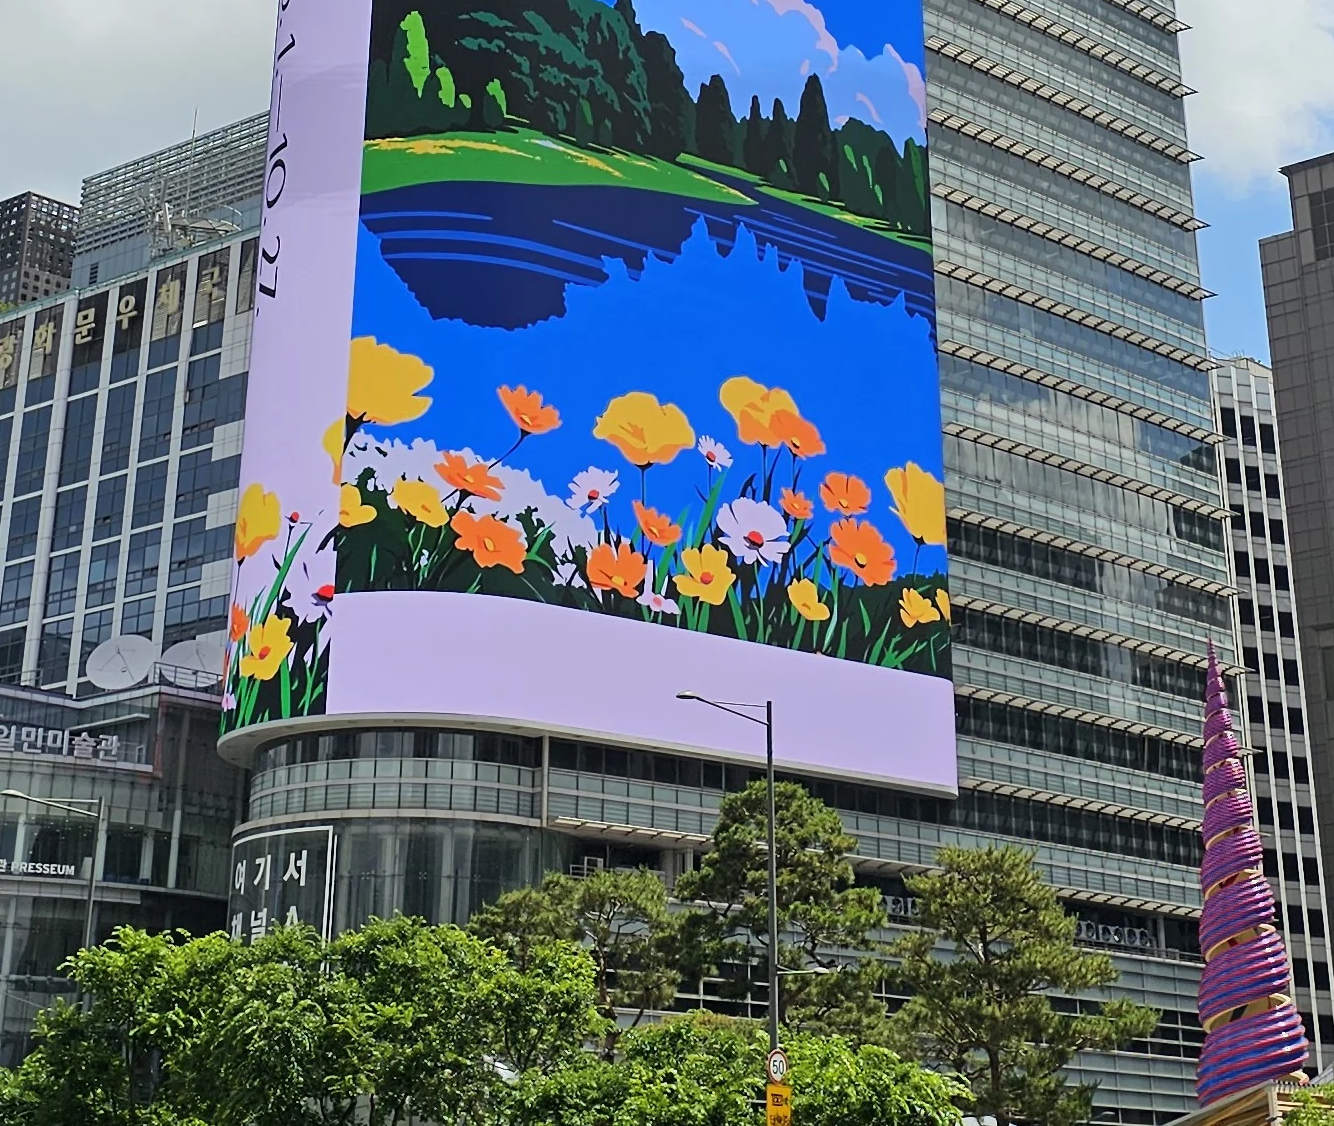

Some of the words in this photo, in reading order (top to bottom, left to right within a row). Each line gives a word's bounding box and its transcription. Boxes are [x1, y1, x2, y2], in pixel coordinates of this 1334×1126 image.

[10, 861, 76, 876] PRESSEUM
[234, 849, 308, 895] 여기서
[772, 1059, 785, 1075] 50
